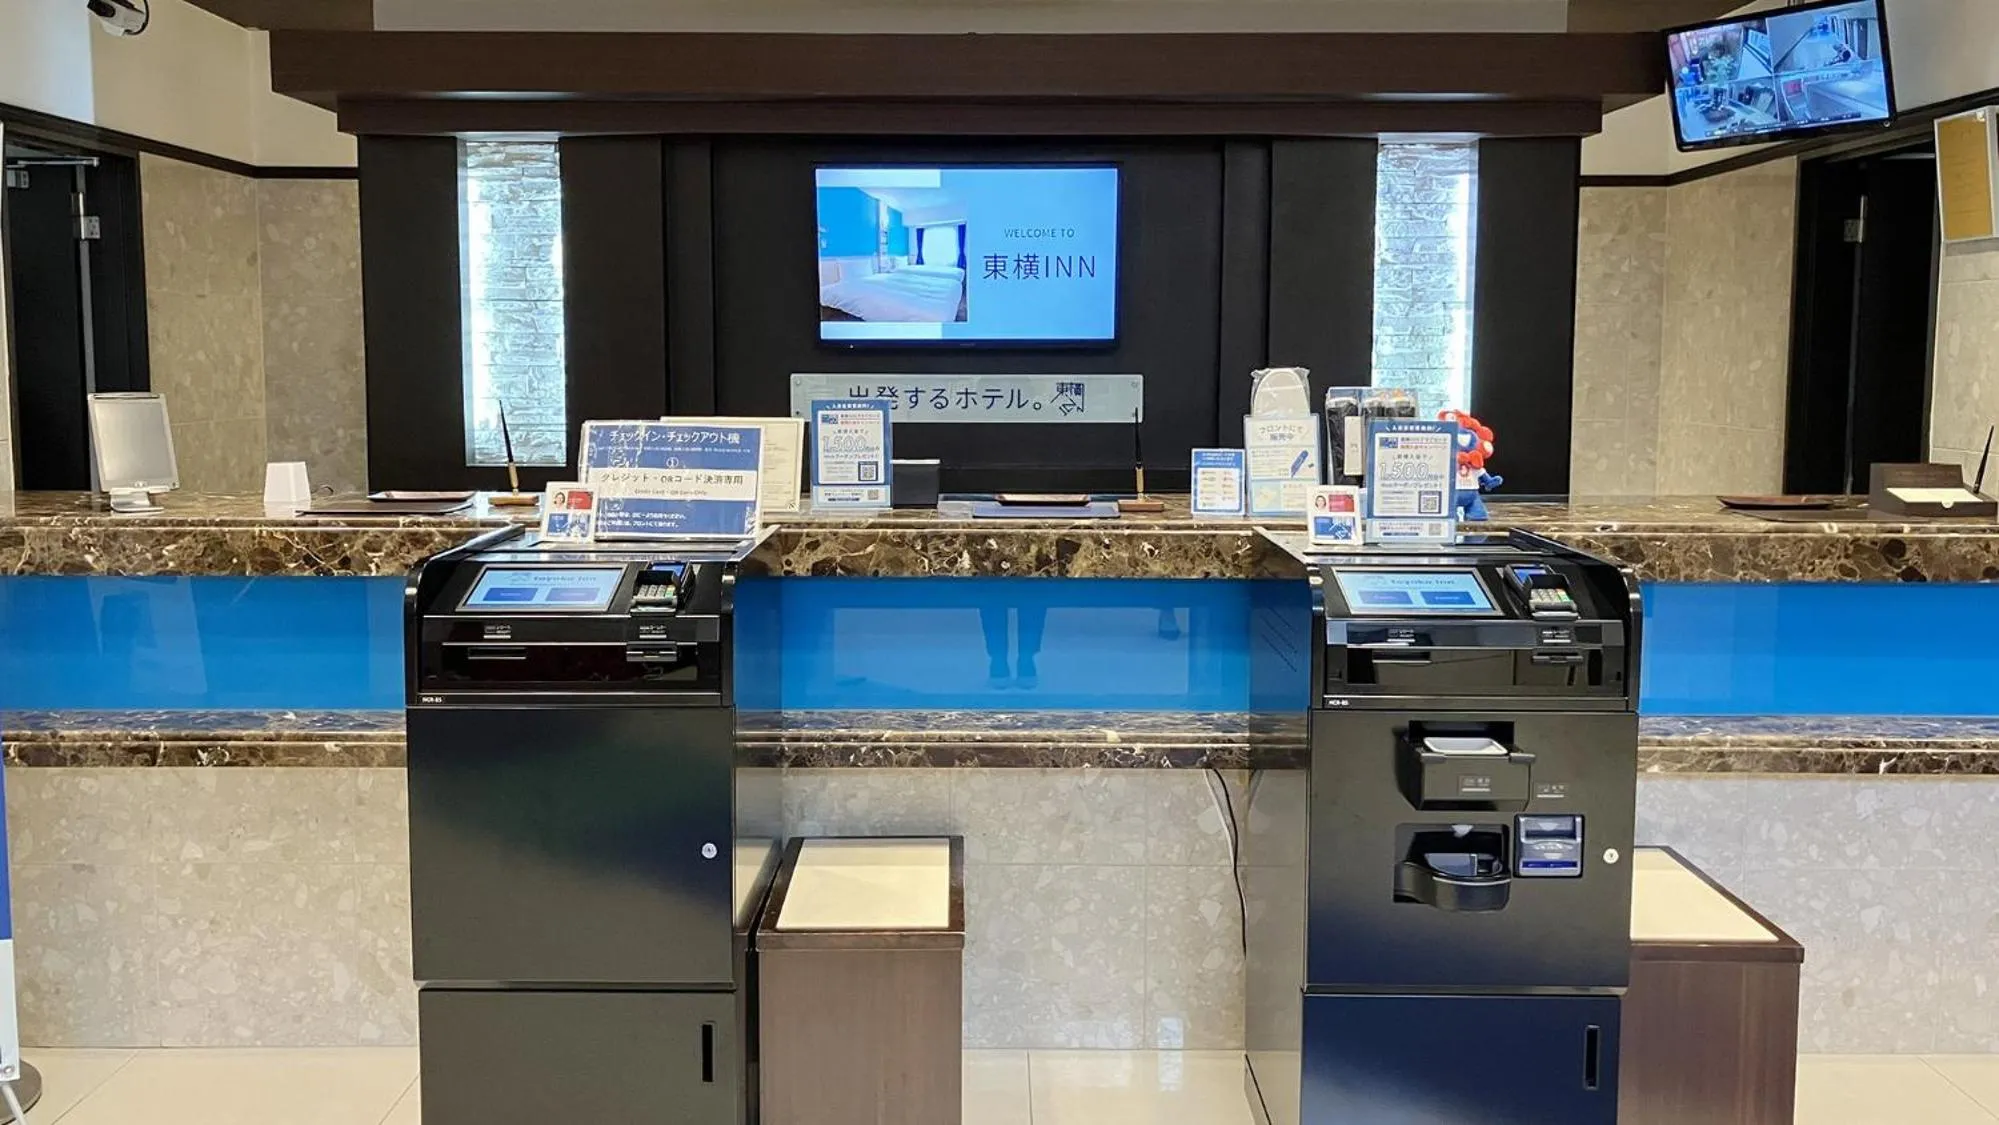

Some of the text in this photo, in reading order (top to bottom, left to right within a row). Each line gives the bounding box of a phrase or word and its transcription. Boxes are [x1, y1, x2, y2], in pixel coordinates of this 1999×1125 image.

[1004, 229, 1075, 238] WELCOME TO
[983, 252, 1095, 280] 東横INN
[609, 430, 740, 444] チェックイン・チェックアウト機
